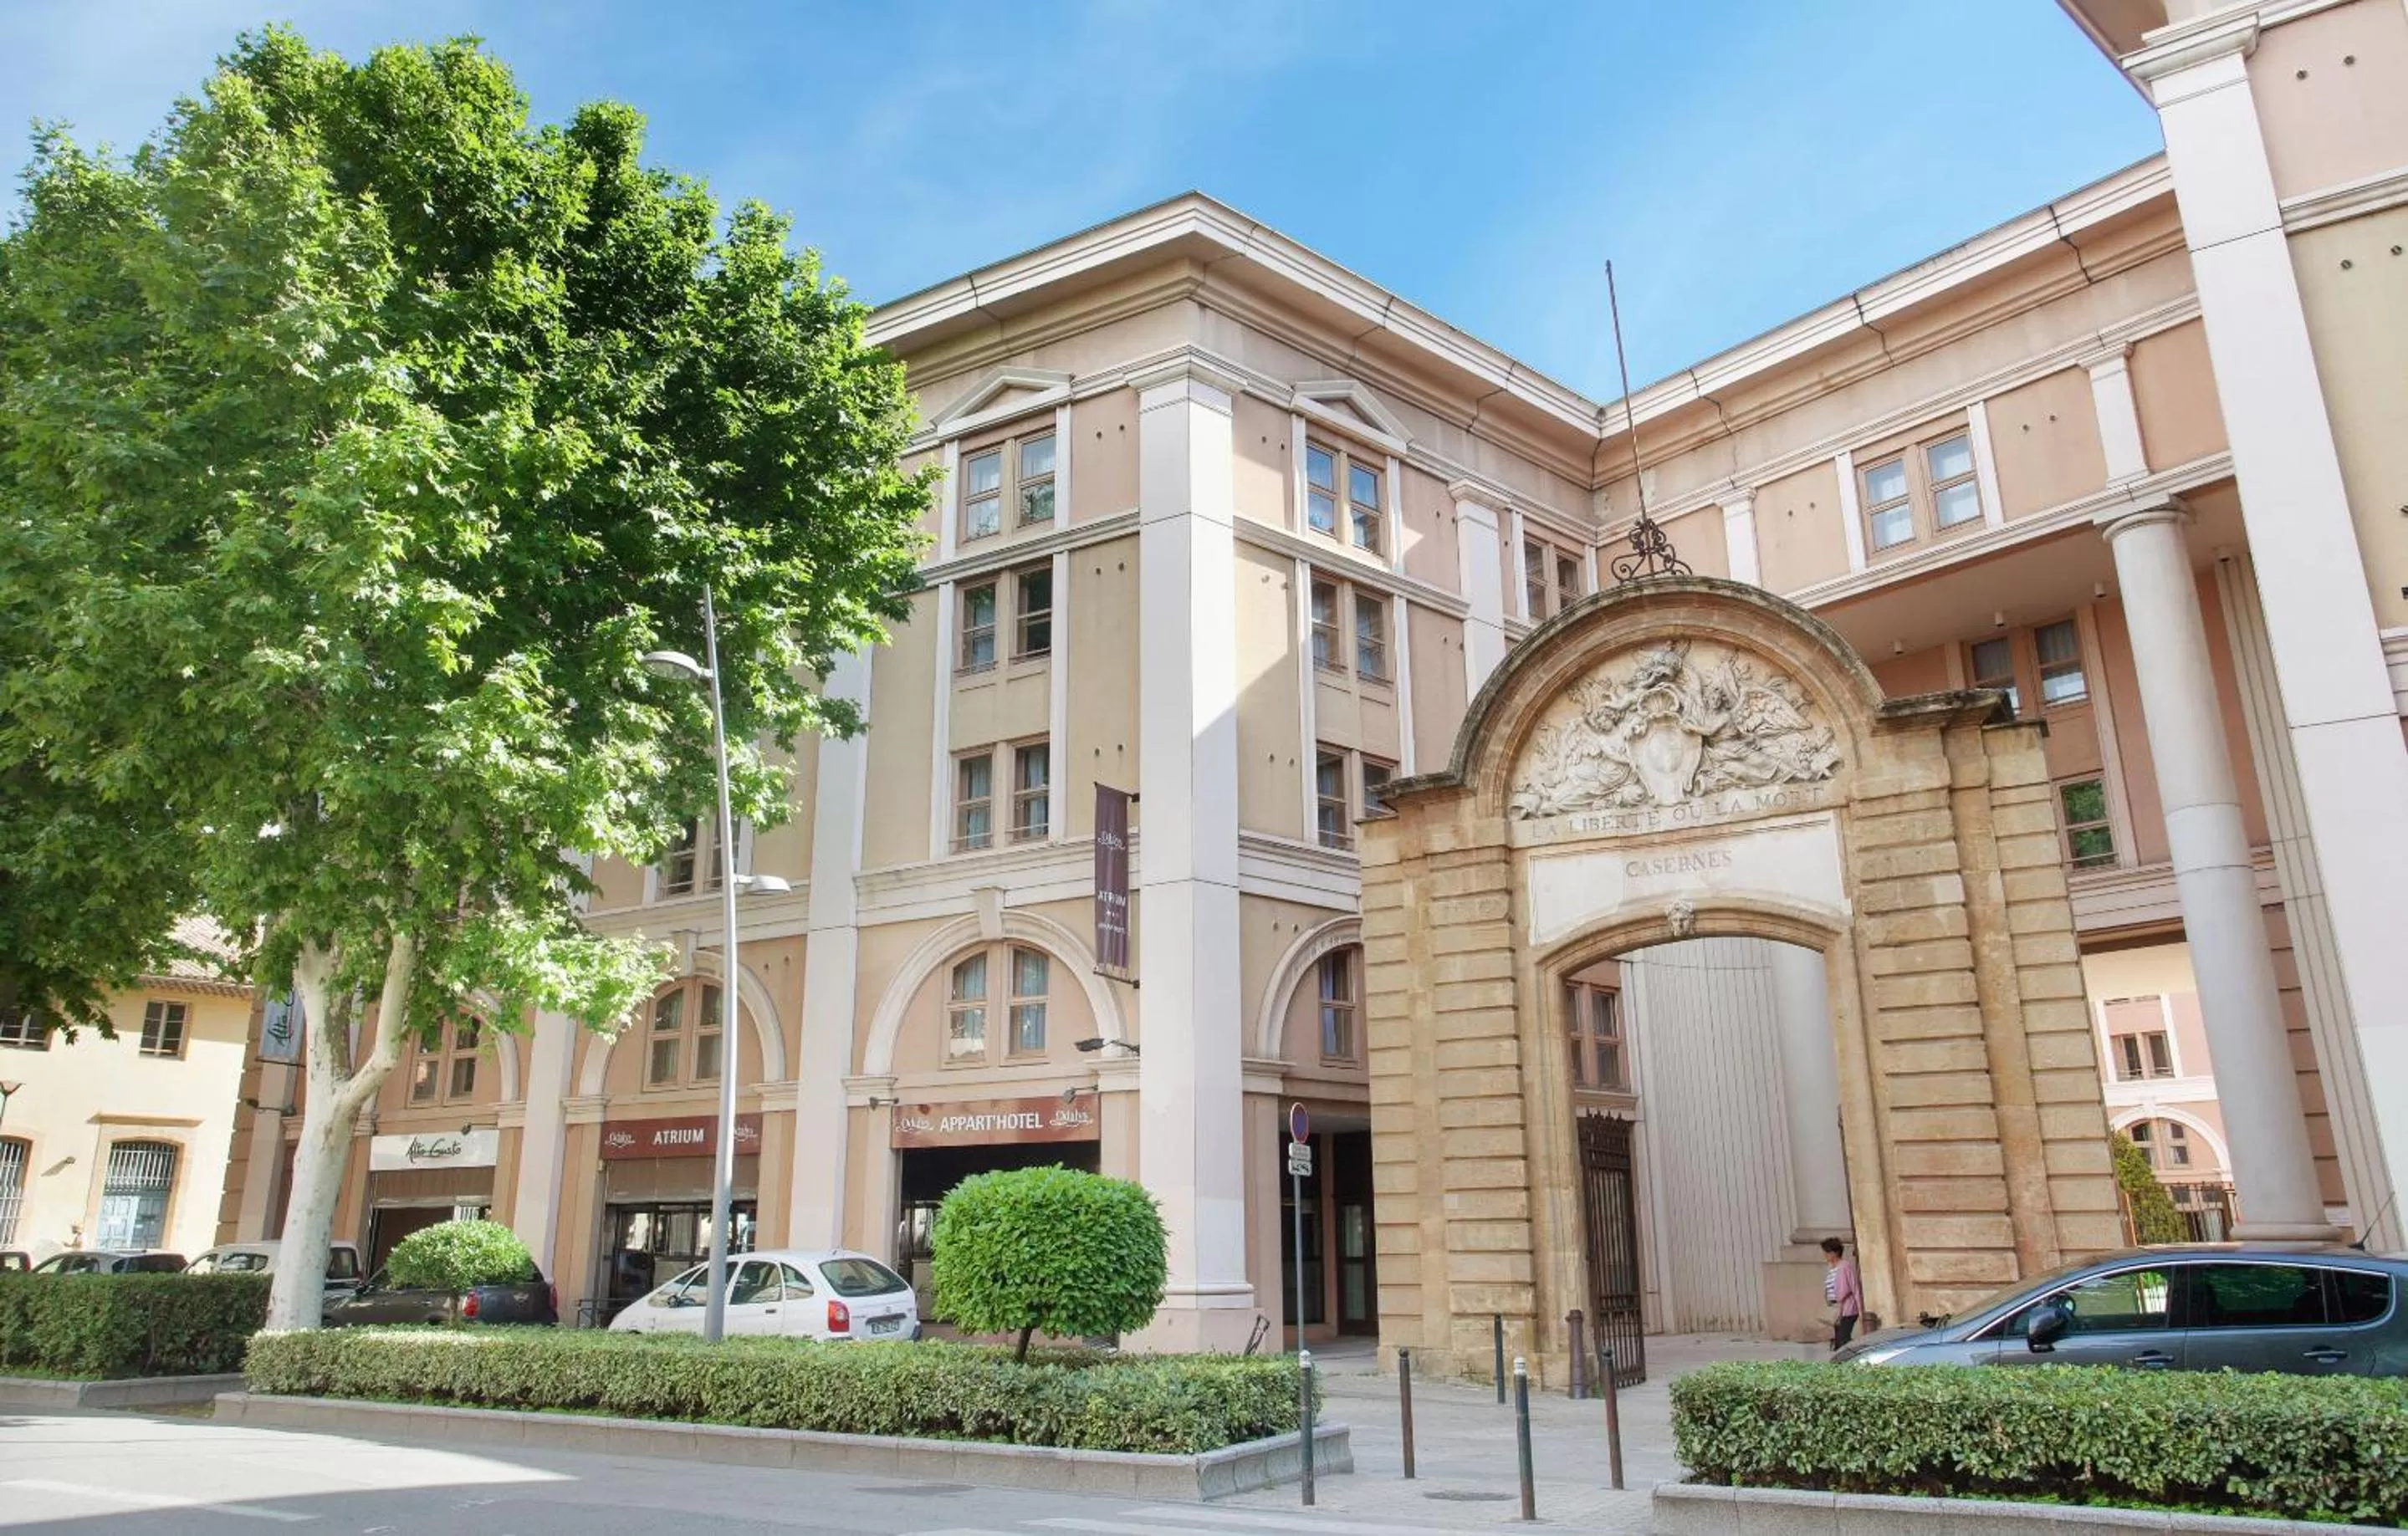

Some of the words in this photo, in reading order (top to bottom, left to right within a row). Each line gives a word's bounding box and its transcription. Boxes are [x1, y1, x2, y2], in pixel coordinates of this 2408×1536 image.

[1673, 805, 1703, 822] OU
[1715, 798, 1746, 816] LA
[1625, 850, 1733, 878] CASERNES
[938, 1112, 1044, 1133] APPART'HOTEL
[652, 1128, 705, 1146] ATRIUM
